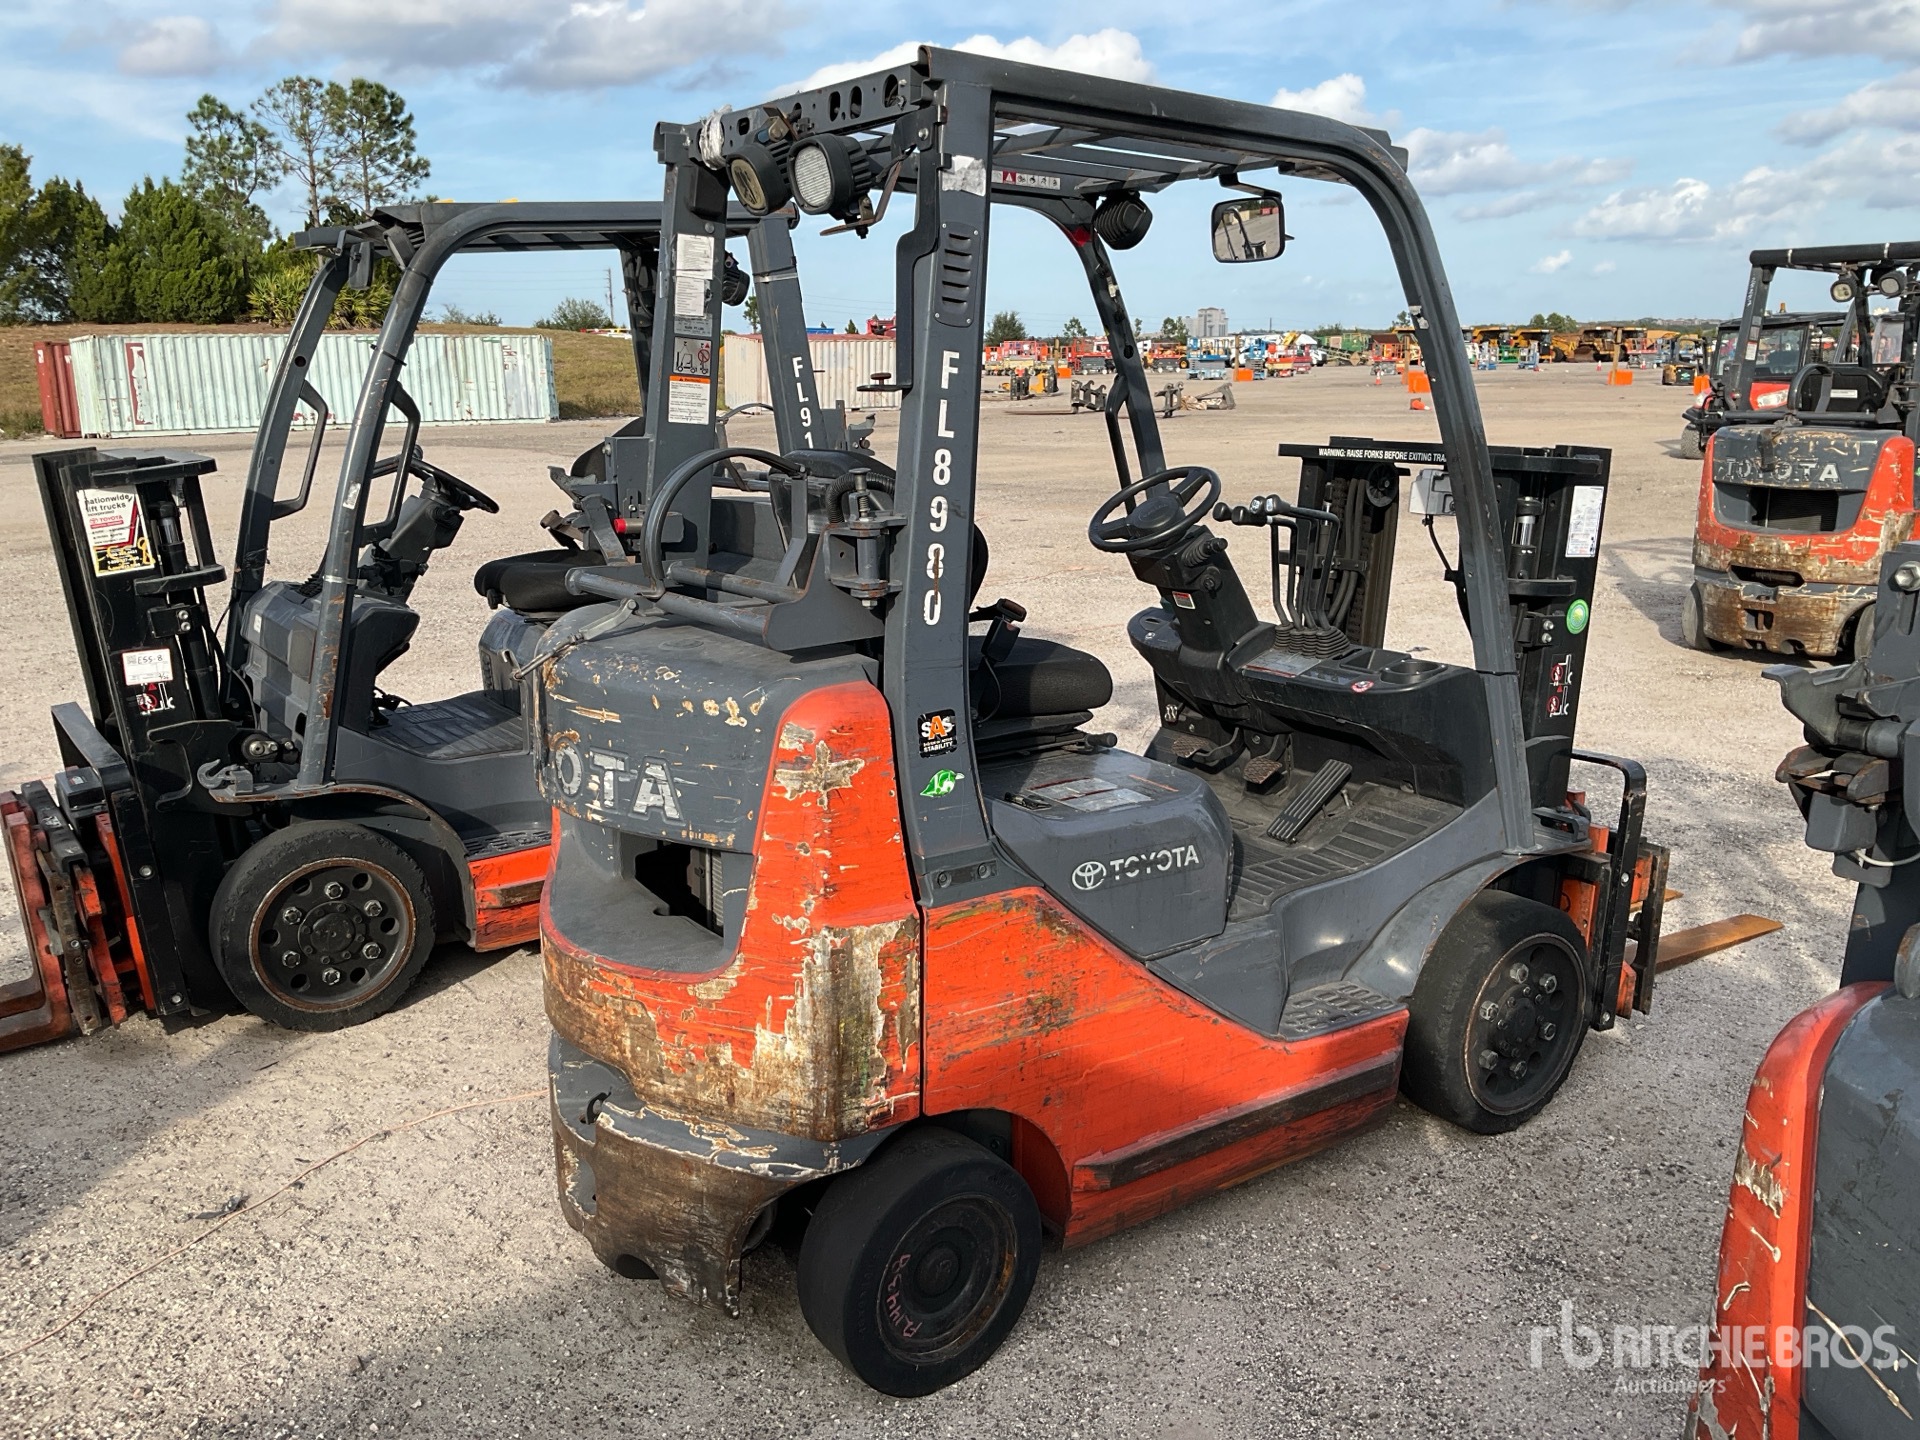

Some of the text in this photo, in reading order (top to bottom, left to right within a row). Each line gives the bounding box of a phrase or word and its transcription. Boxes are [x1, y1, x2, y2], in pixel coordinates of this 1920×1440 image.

[1318, 448, 1447, 462] WARNING: RAISE FORKS BEFORE EXITING TRA
[923, 350, 960, 626] FL8980
[84, 493, 130, 506] nationwide
[100, 501, 127, 512] trucks
[921, 715, 955, 740] SAS
[923, 741, 954, 753] STABILITY
[1109, 844, 1200, 881] TOYOTA
